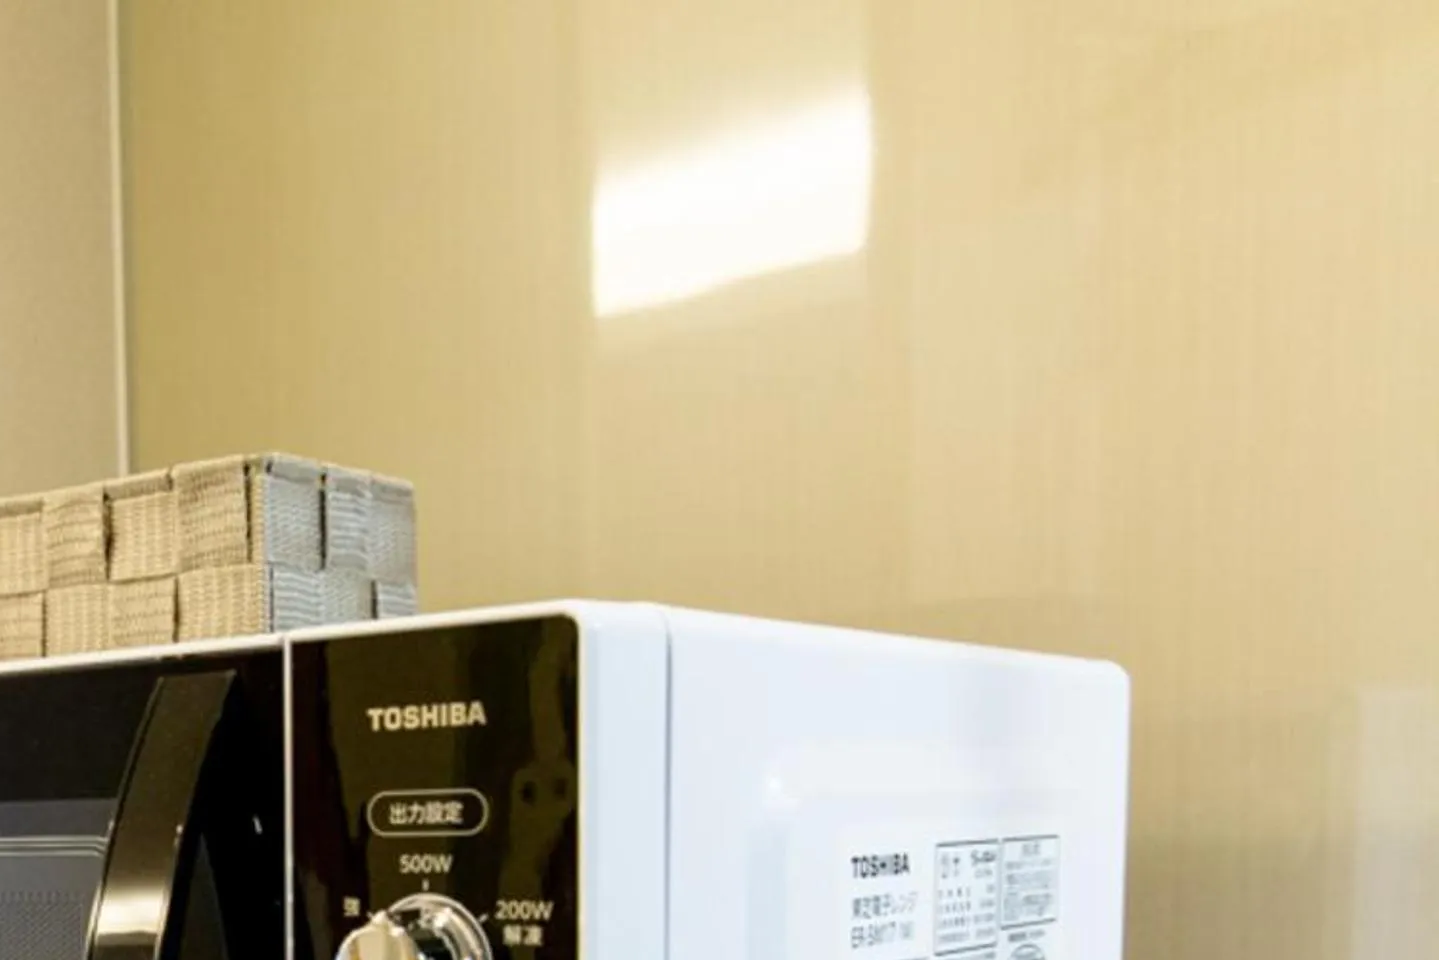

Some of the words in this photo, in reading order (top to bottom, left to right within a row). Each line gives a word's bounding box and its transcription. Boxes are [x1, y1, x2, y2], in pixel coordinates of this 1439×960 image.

[367, 701, 486, 731] TOSHIBA
[389, 801, 464, 825] 出力設定
[399, 854, 453, 874] 500W
[850, 852, 910, 878] TOSHIBA
[494, 899, 554, 921] 200W
